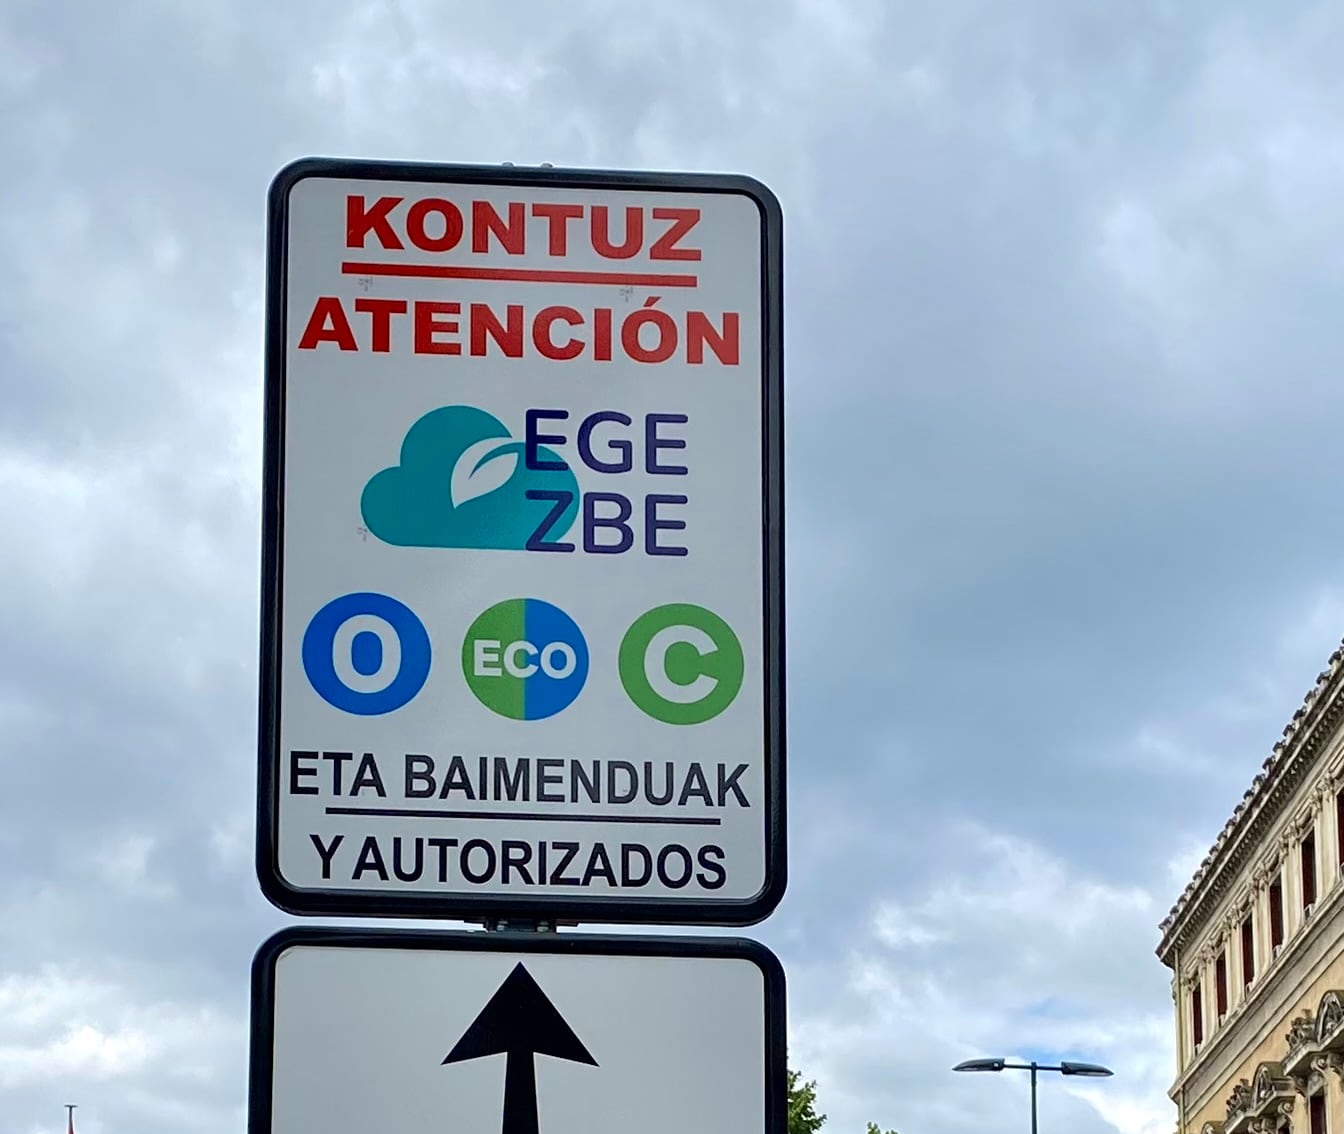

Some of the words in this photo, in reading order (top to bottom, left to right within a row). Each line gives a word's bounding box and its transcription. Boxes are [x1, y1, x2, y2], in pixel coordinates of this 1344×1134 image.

[345, 194, 702, 262] KONTUZ
[298, 296, 740, 366] ATENCIÓN
[524, 408, 689, 476] EGE
[523, 489, 689, 557] ZBE
[472, 638, 577, 680] ECO
[643, 623, 720, 704] C
[289, 750, 387, 798] ETA
[403, 754, 751, 807] BAIMENDUAK
[309, 833, 346, 880] Y
[351, 835, 727, 890] AUTORIZADOS
